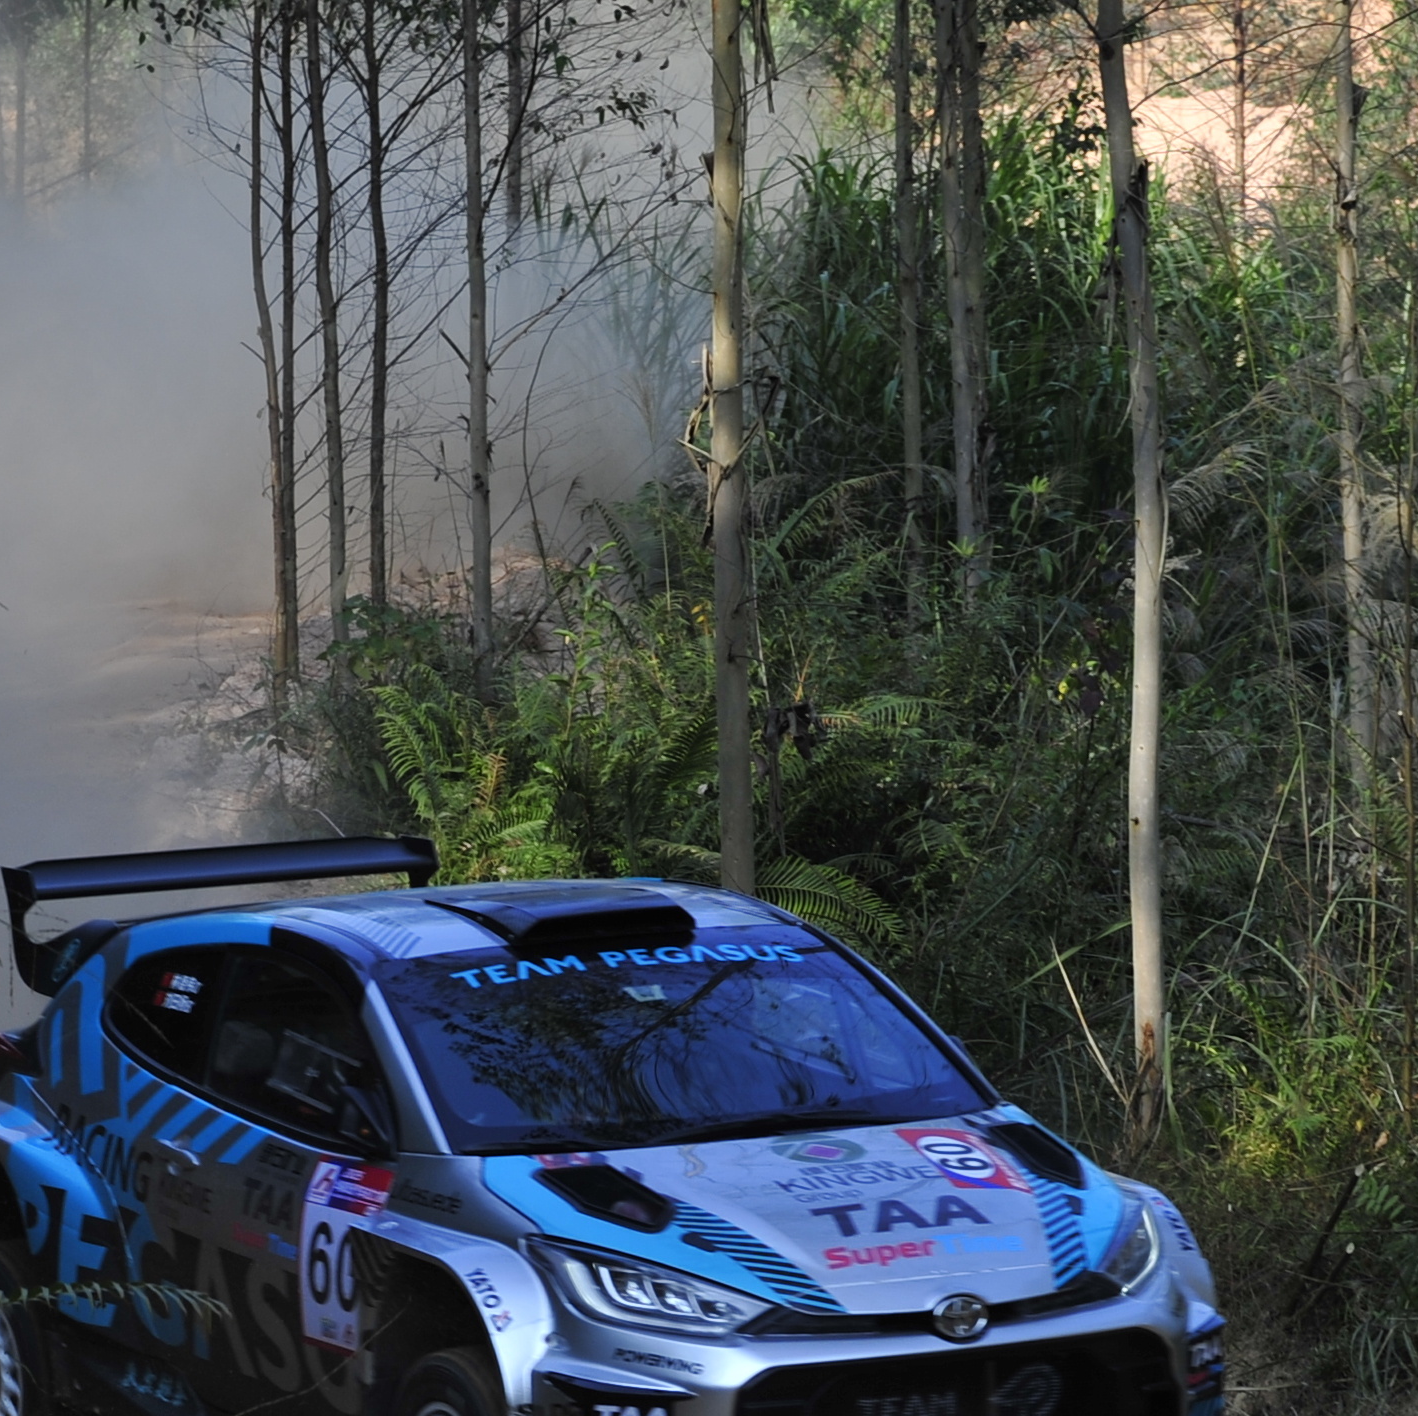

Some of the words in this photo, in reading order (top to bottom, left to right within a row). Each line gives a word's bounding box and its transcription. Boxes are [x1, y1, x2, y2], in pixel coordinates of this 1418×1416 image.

[450, 954, 588, 989] TEAM
[597, 943, 805, 968] PEGASUS
[54, 1103, 153, 1202] RACING
[924, 1142, 989, 1171] 60
[242, 1177, 294, 1230] TAA
[809, 1194, 992, 1237] TAA
[308, 1221, 358, 1312] 60
[464, 1268, 502, 1309] YATO
